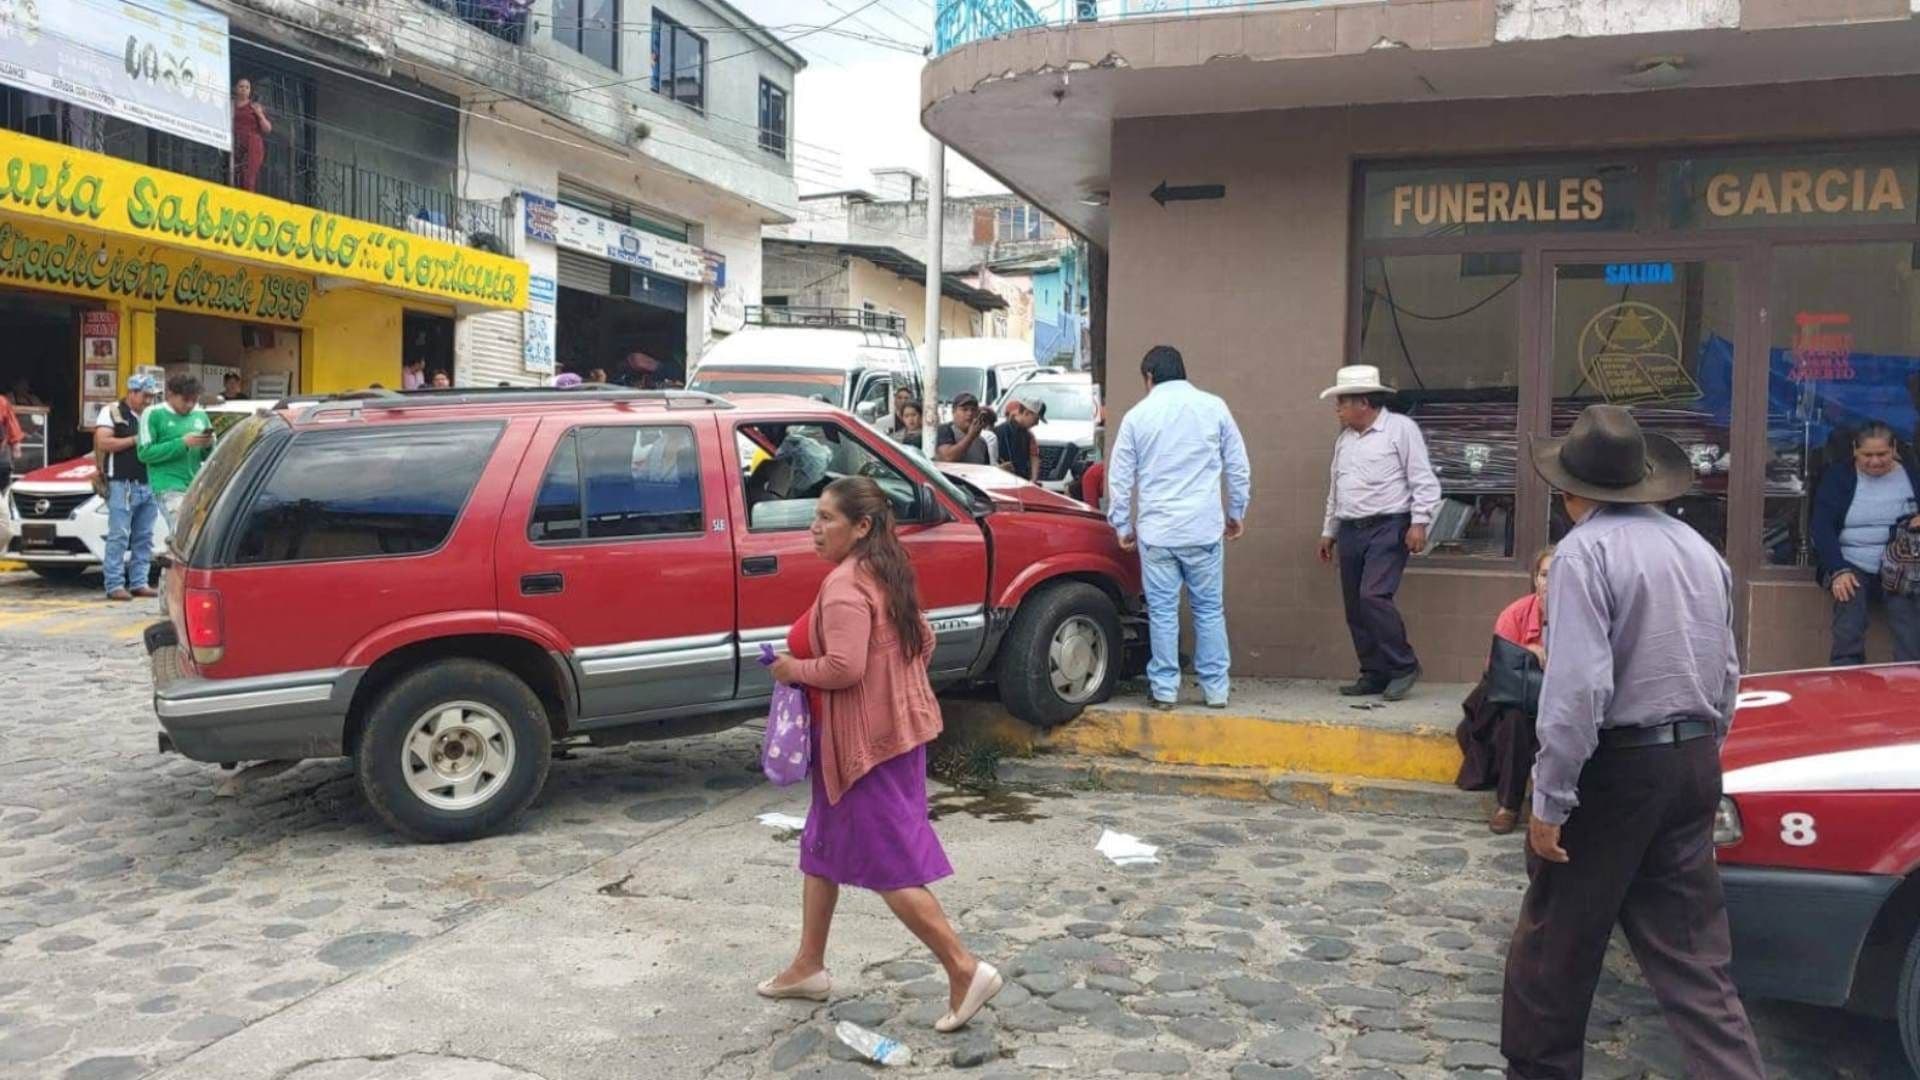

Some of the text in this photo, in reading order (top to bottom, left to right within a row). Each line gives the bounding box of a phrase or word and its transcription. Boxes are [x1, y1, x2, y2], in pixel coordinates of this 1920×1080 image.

[1393, 167, 1905, 226] FUNERALES GARCIA
[1604, 262, 1674, 285] SALIDA
[257, 272, 309, 321] 1999
[1780, 812, 1818, 847] 8
